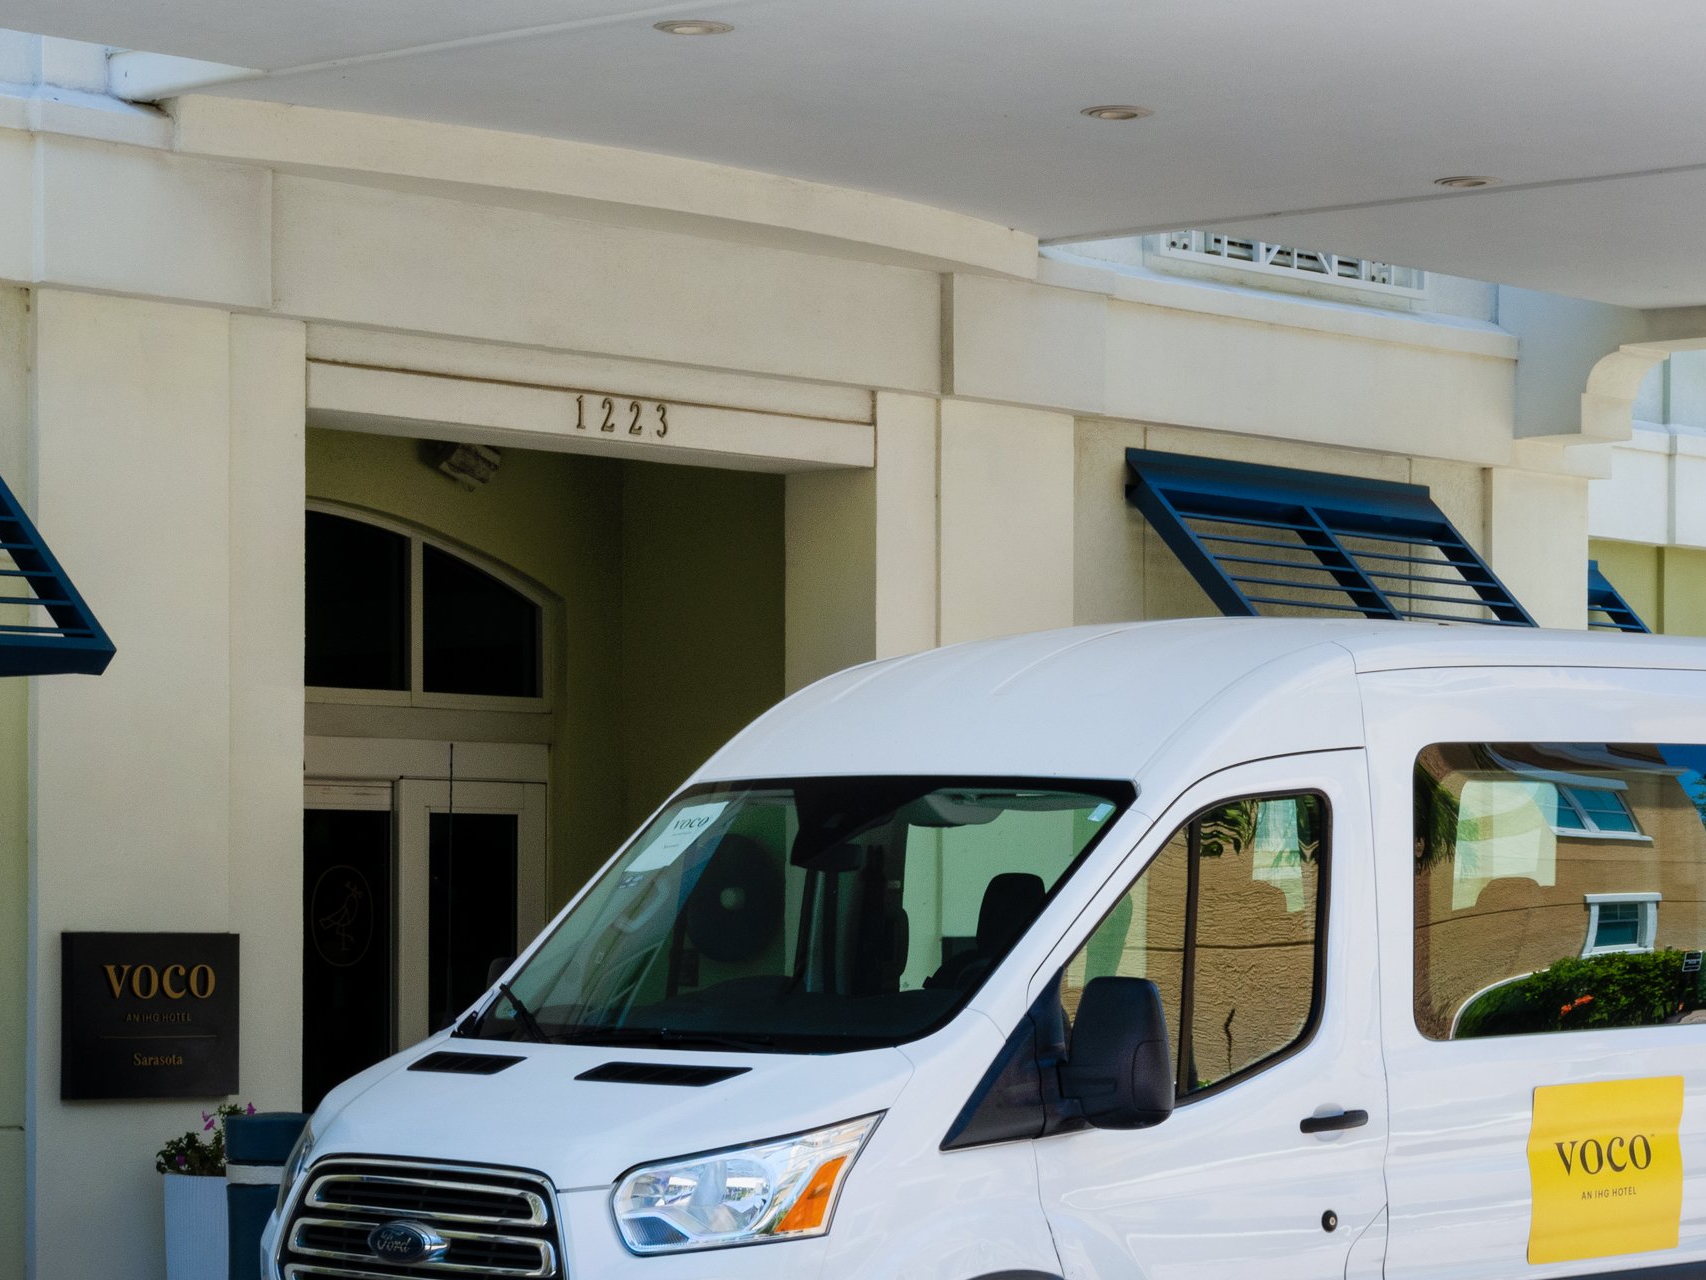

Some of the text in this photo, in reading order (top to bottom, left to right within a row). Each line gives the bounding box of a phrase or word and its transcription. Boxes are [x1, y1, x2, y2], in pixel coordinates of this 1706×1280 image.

[577, 395, 668, 438] 1223
[673, 816, 710, 830] VOCO
[104, 964, 216, 999] VOCO
[126, 1012, 192, 1023] AN IHG HOTEL
[133, 1053, 183, 1066] Sarasota
[1554, 1134, 1652, 1176] VOCO
[1581, 1186, 1637, 1200] AN IHG HOTEL
[377, 1231, 412, 1252] Ford
